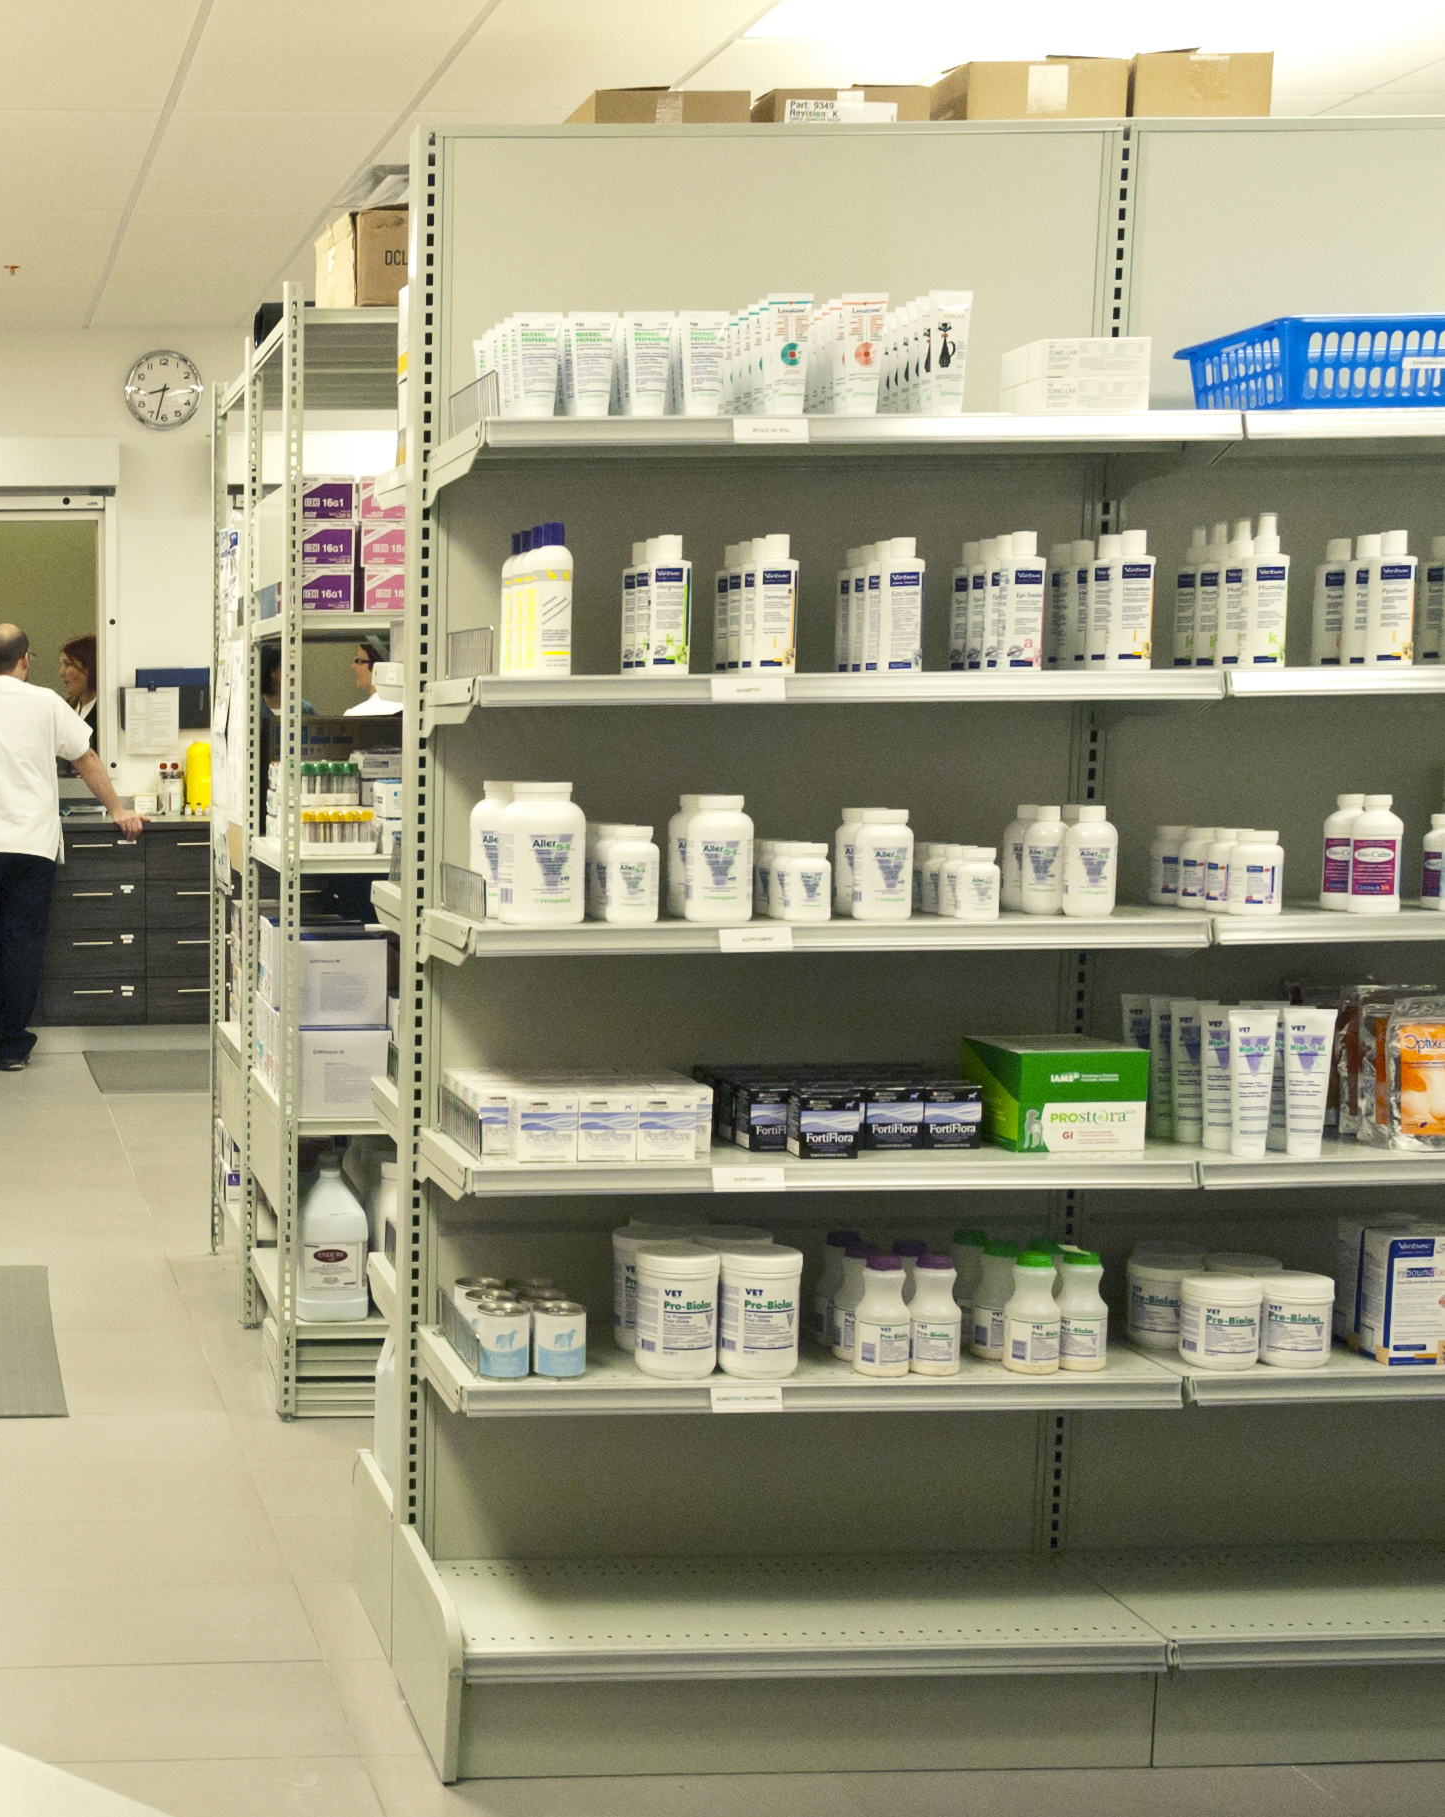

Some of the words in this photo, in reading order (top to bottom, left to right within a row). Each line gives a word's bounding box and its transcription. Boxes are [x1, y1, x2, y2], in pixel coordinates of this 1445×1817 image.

[790, 100, 810, 109] Part:
[814, 101, 834, 109] 9349
[790, 109, 829, 117] Revision:
[385, 250, 408, 265] DCL
[159, 358, 169, 366] 12
[137, 373, 145, 381] 10
[148, 410, 154, 418] 7
[756, 1125, 787, 1135] FortiFl
[872, 1123, 918, 1134] FortiFlora
[929, 1123, 976, 1134] FortiFlora
[806, 1132, 854, 1143] FortiFlora
[1062, 1131, 1074, 1139] GI
[664, 1289, 682, 1297] VET
[745, 1288, 764, 1296] VET
[663, 1300, 712, 1311] Pro-Biolac
[744, 1299, 793, 1310] Pro-Biolac
